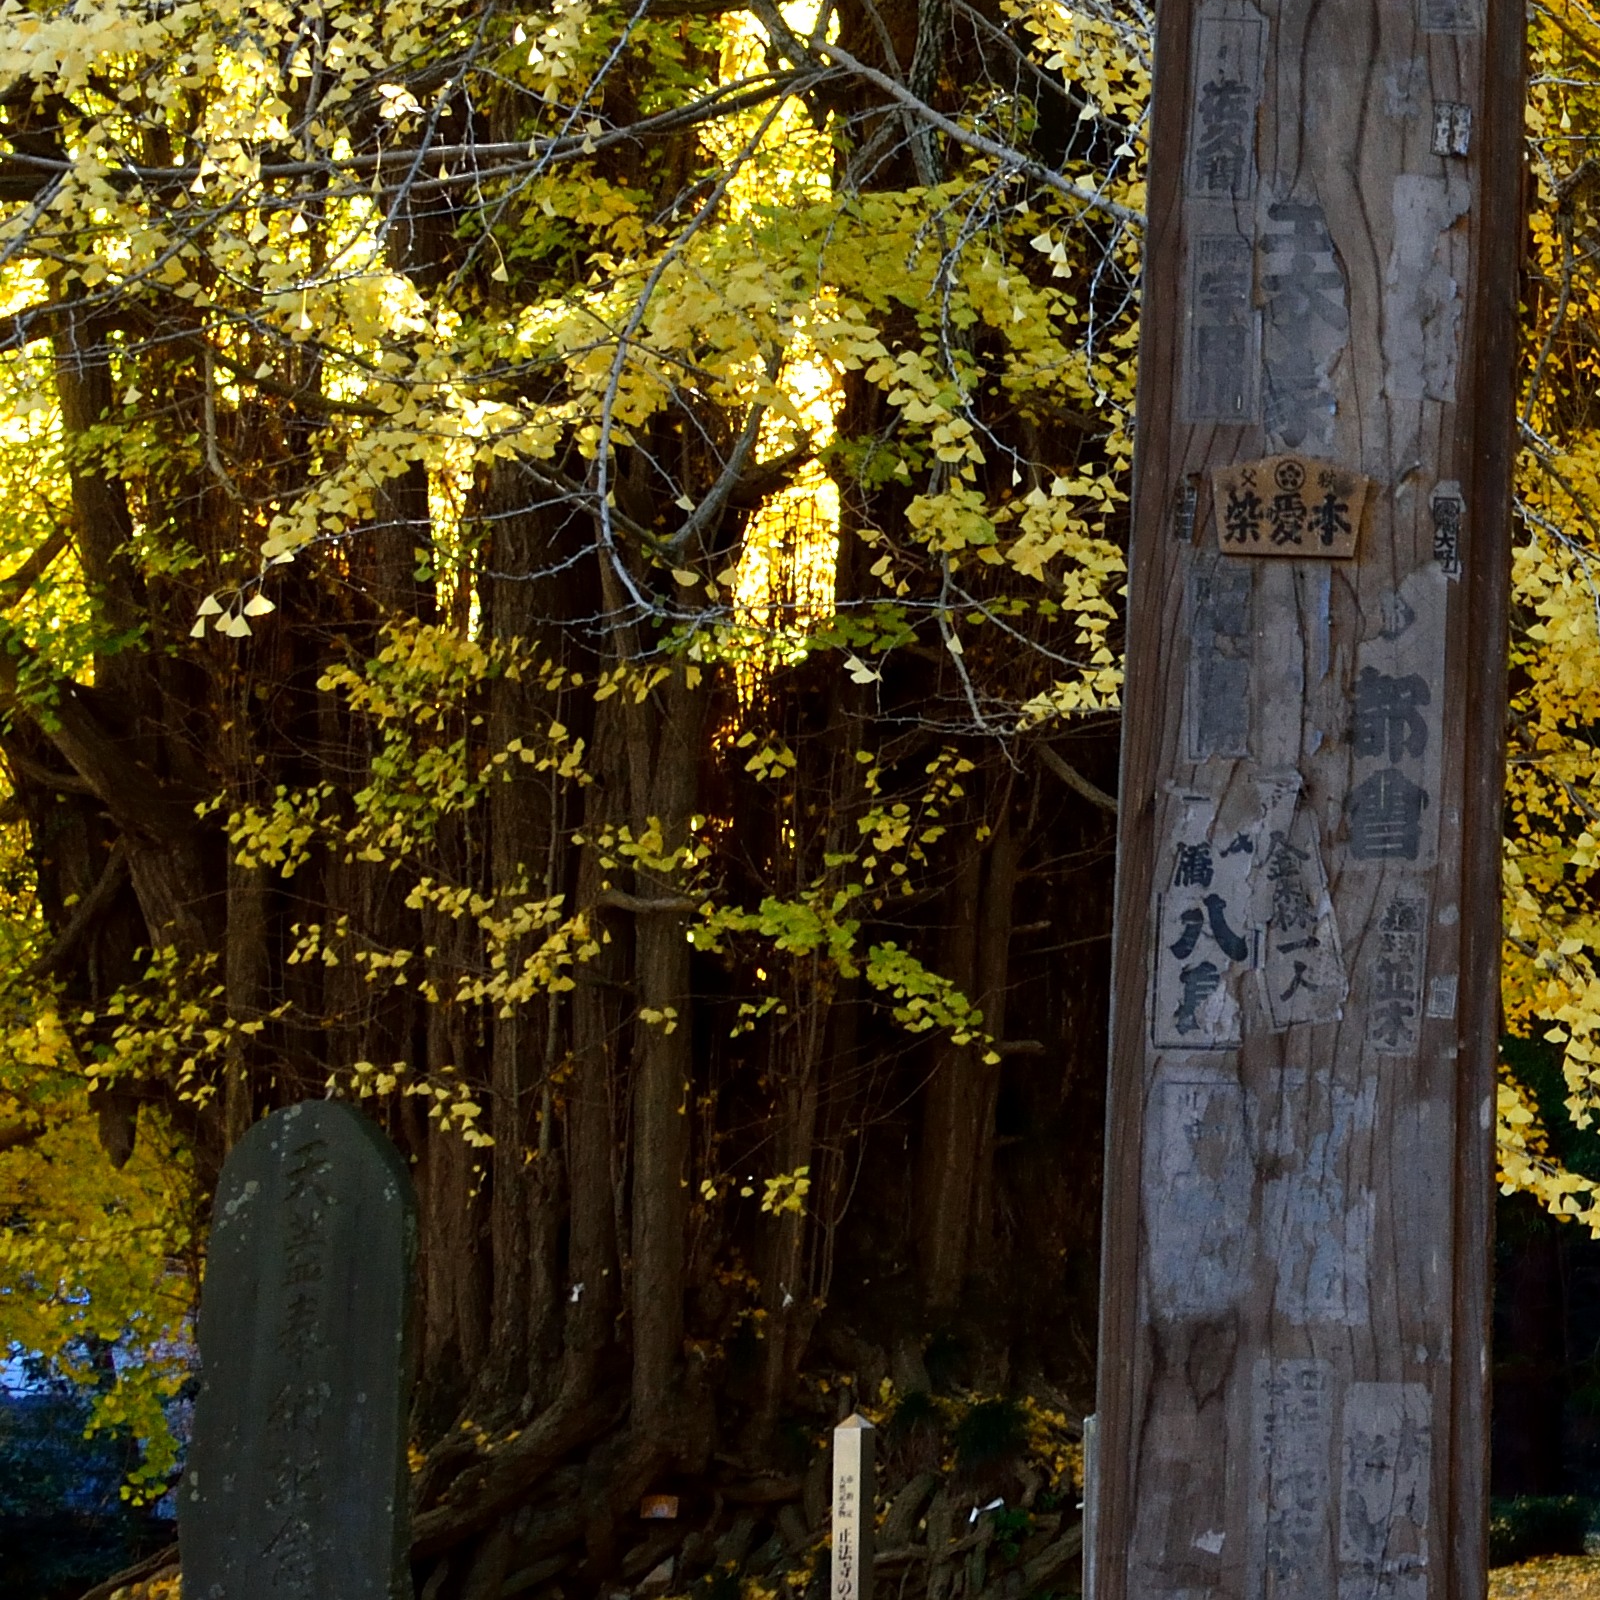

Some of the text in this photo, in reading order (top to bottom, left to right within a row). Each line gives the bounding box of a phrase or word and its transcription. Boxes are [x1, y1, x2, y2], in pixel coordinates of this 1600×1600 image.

[1195, 81, 1252, 191] 佐久間
[838, 1528, 852, 1600] 正法寺の
